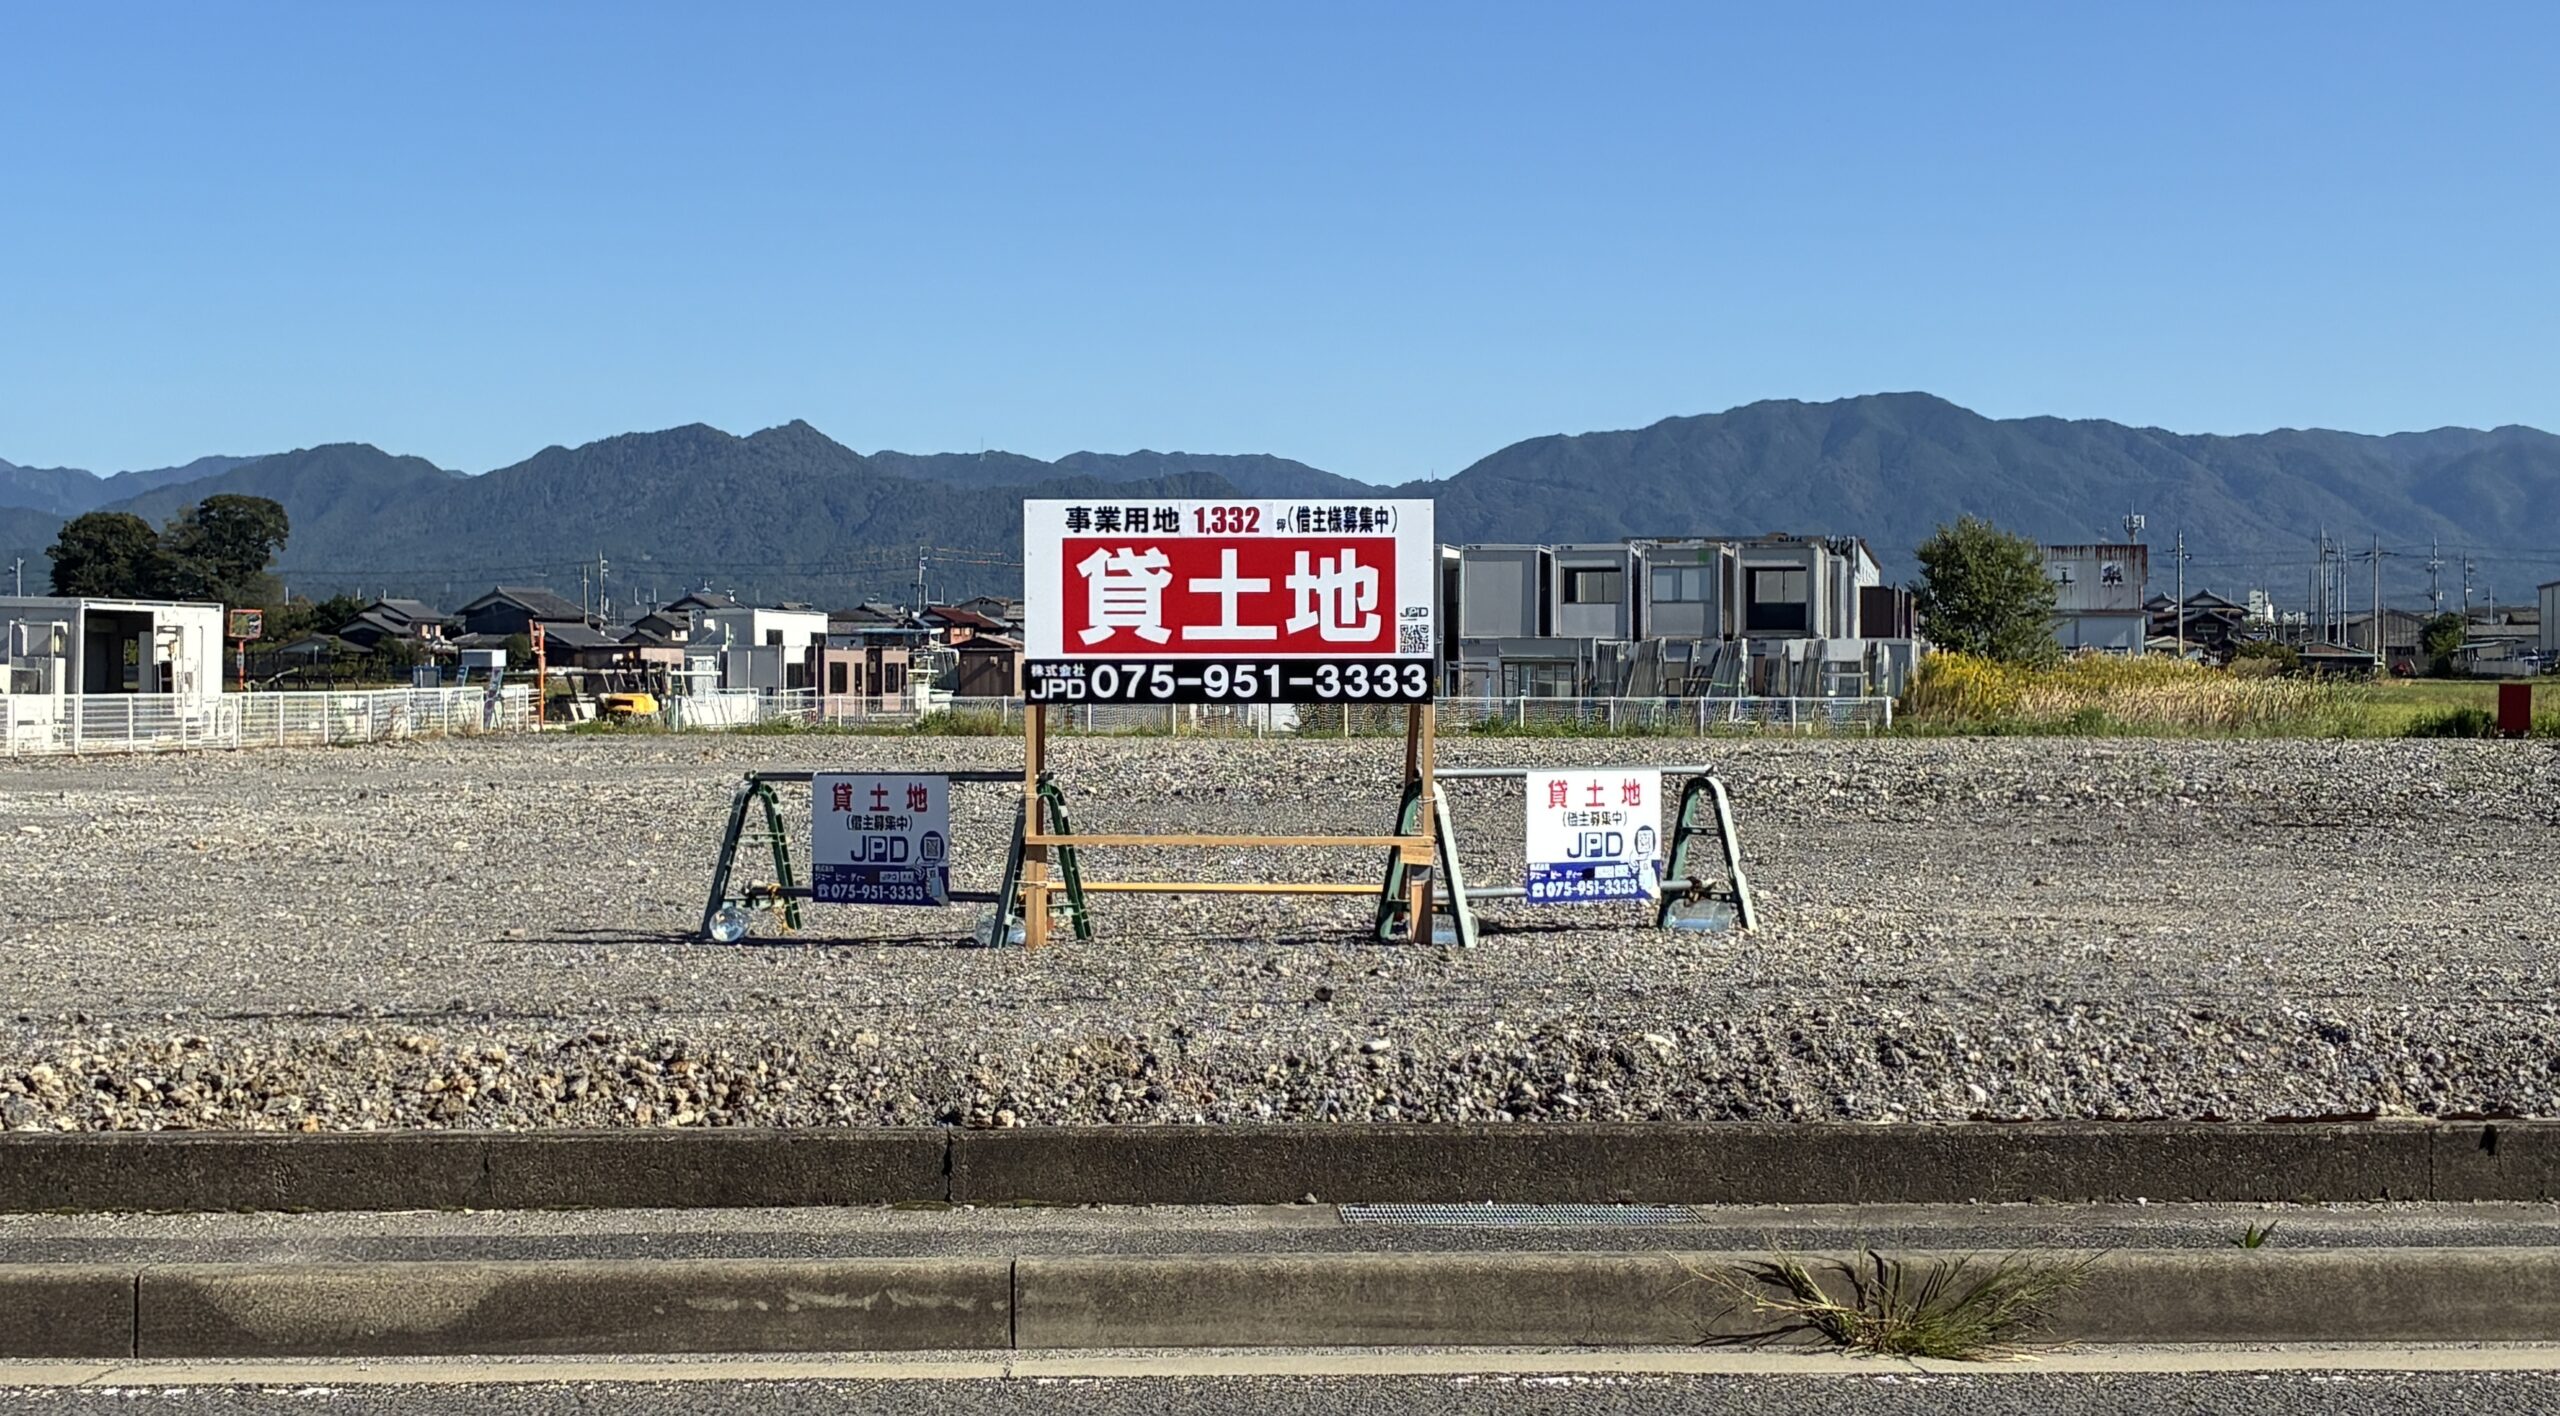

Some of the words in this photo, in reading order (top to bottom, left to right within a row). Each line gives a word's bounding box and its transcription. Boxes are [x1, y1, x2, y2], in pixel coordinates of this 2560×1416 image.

[1066, 506, 1180, 533] 事業用地
[1194, 506, 1260, 535] 1,332
[1075, 547, 1382, 645] 貸土地
[1031, 664, 1085, 676] 株式会社
[1091, 664, 1428, 699] 075-951-3333
[1031, 679, 1086, 699] JPD
[832, 782, 928, 812] 貸土地
[1548, 779, 1641, 809] 貸土地
[851, 835, 908, 862] JPD
[1567, 832, 1623, 858] JPD
[831, 884, 923, 900] 075-951-3333
[1546, 878, 1637, 897] 075-951-3333
